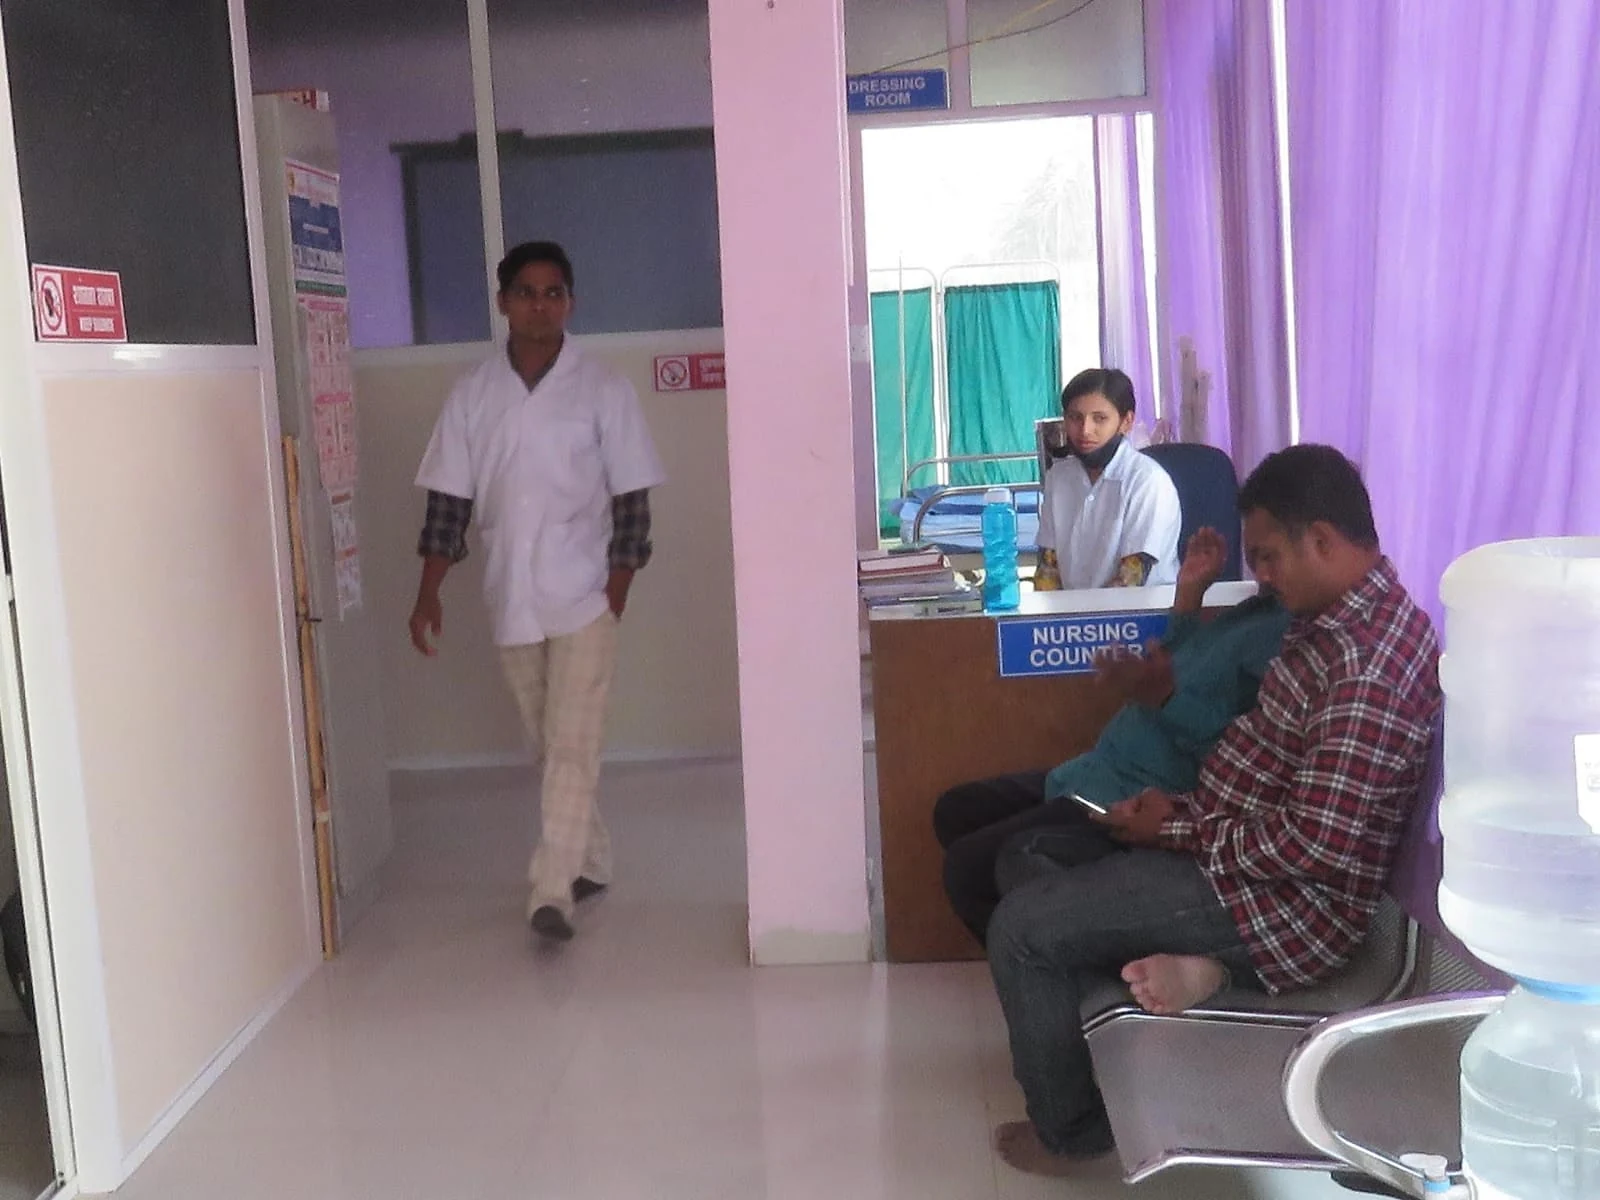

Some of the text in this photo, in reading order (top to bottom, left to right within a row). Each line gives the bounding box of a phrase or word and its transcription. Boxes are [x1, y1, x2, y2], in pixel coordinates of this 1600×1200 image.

[849, 77, 926, 93] DRESSING
[865, 92, 911, 107] ROOM
[1033, 622, 1139, 645] NURSING
